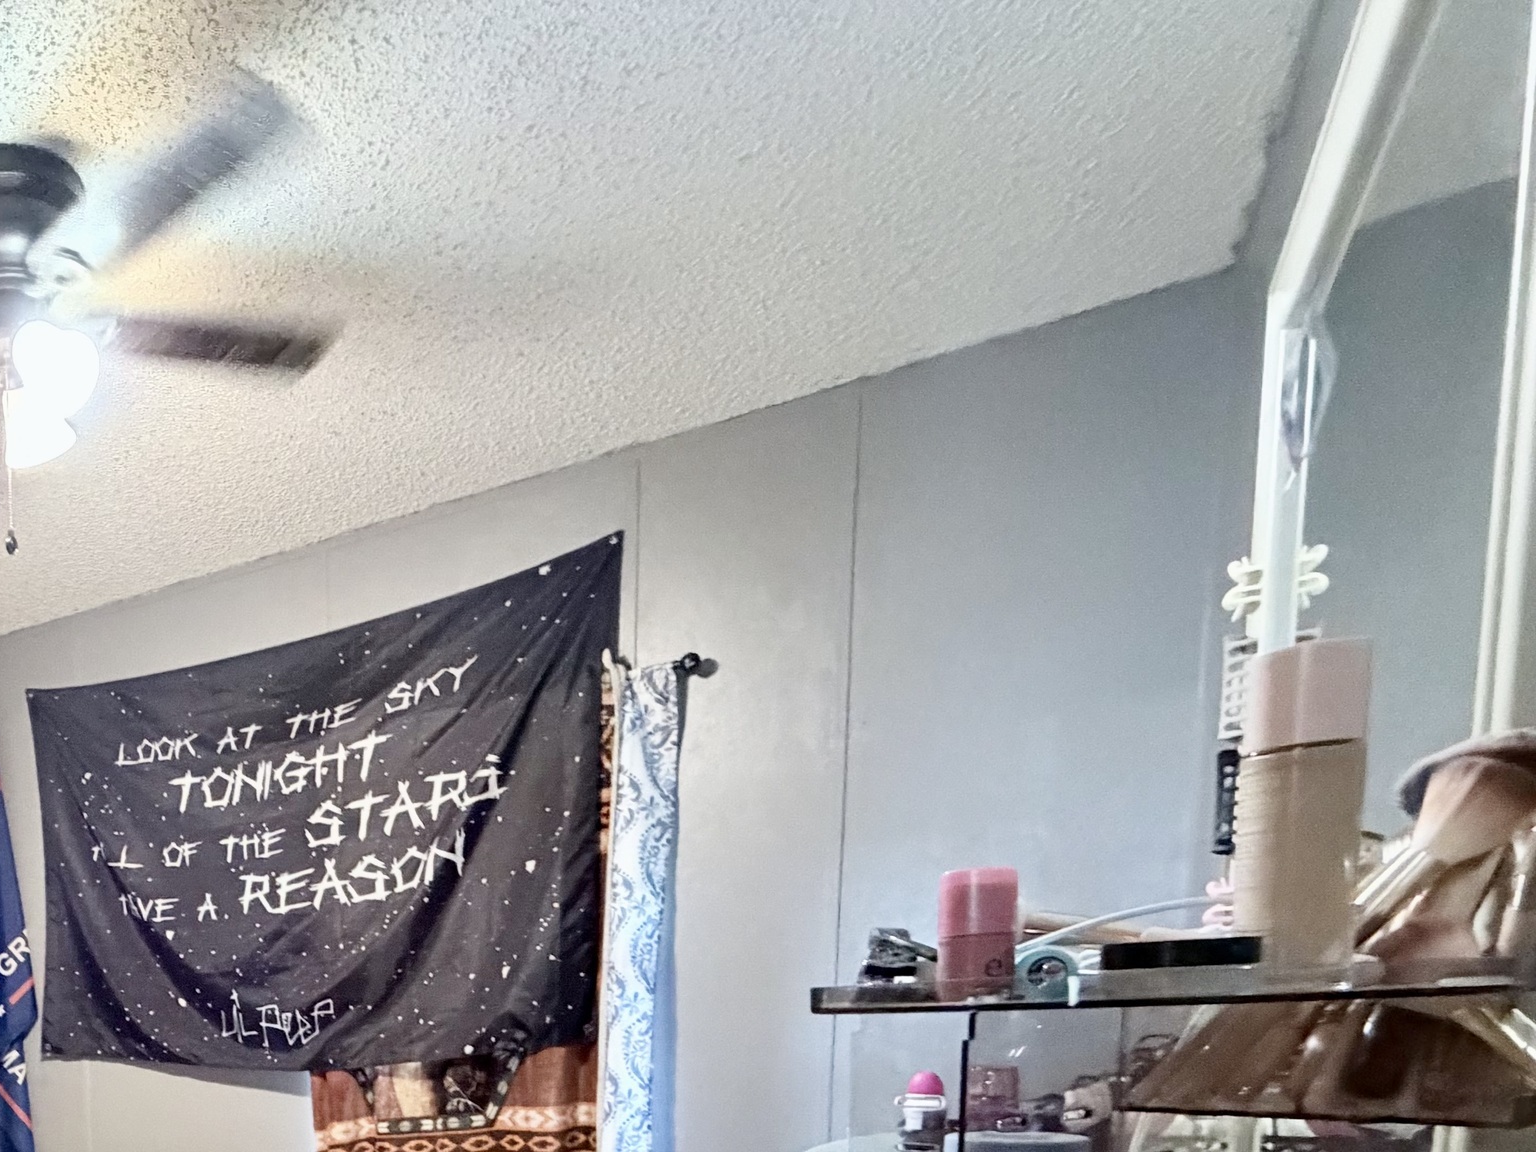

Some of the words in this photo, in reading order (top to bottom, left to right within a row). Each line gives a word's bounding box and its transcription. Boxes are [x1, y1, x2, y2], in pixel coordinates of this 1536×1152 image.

[115, 733, 199, 767] LOOK
[217, 723, 262, 755] AT
[286, 698, 363, 739] THE
[384, 654, 478, 714] SKY
[169, 729, 393, 814] TONIGHT
[162, 841, 204, 868] OF
[219, 828, 286, 864] THE
[197, 893, 218, 922] A
[238, 827, 465, 915] REASON
